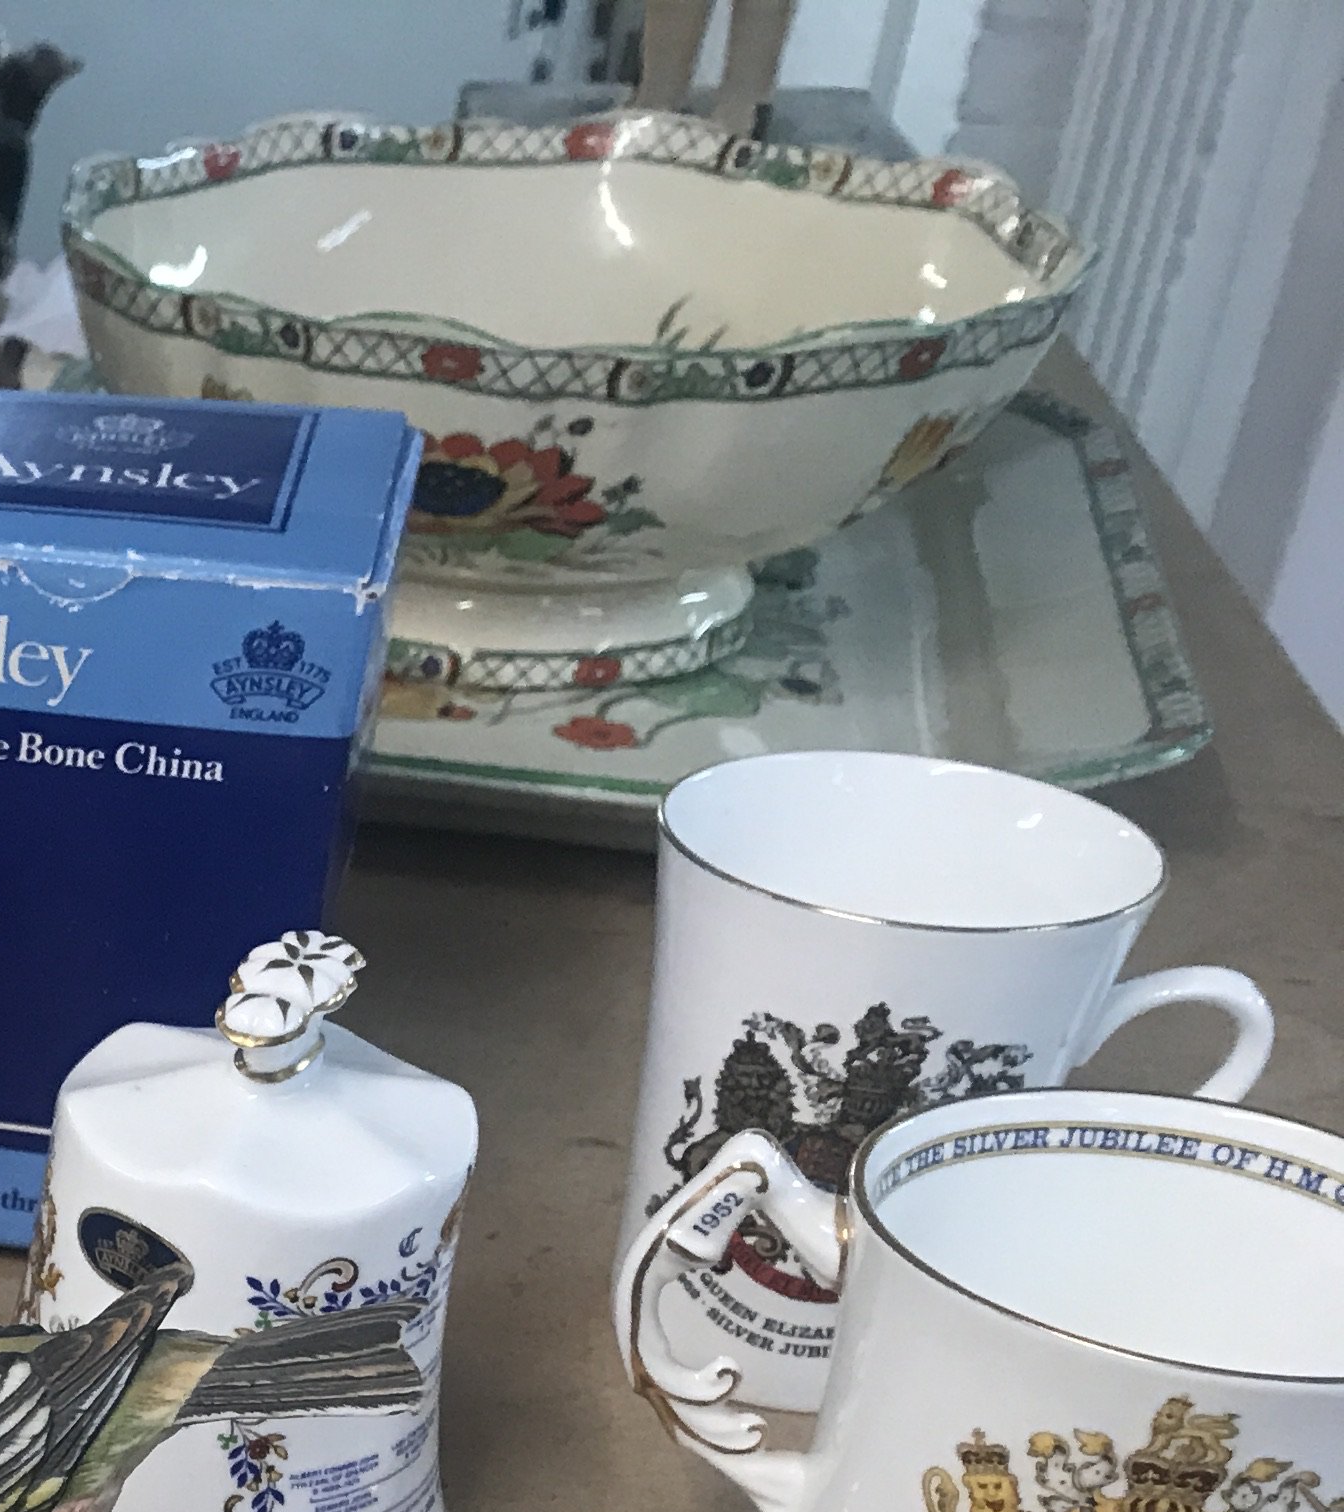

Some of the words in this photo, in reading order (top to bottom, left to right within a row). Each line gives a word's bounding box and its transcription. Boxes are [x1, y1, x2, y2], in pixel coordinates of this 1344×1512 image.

[226, 676, 313, 701] AYNSLEY
[230, 707, 299, 723] ENGLAND
[17, 732, 106, 772] Bone
[115, 741, 225, 783] China
[906, 1143, 945, 1175] THE
[952, 1127, 1051, 1157] SILVER
[1059, 1127, 1203, 1159] JUBILEE
[1211, 1143, 1261, 1171] OF
[0, 1188, 38, 1213] thr
[693, 1192, 744, 1236] 1952
[700, 1272, 759, 1321] QUEEN
[706, 1306, 774, 1352] SILVER
[779, 1342, 830, 1359] JUBI
